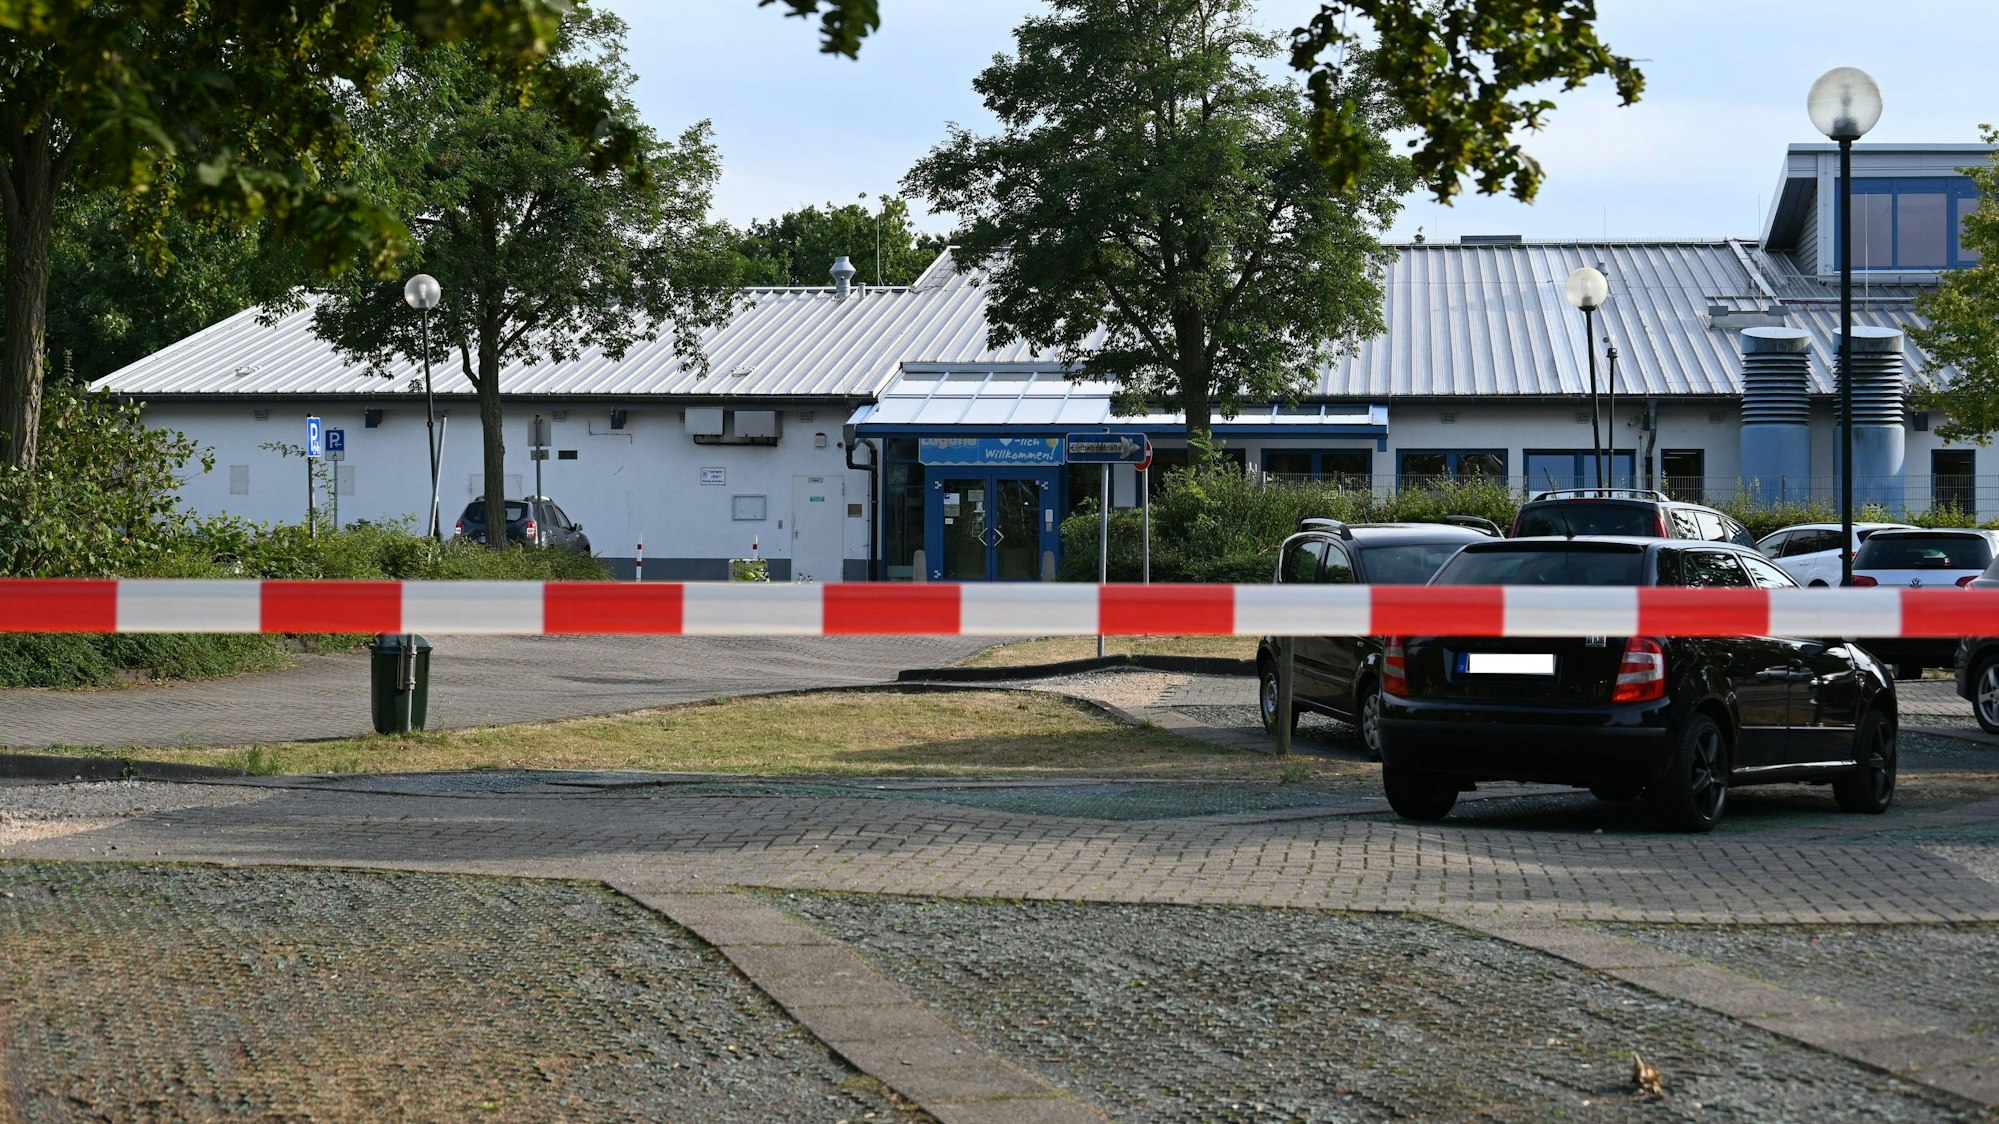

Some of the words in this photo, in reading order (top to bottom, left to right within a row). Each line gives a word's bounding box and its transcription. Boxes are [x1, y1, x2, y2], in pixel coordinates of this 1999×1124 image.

[310, 422, 318, 452] P
[329, 432, 340, 449] P
[985, 446, 1056, 460] Willkommen!
